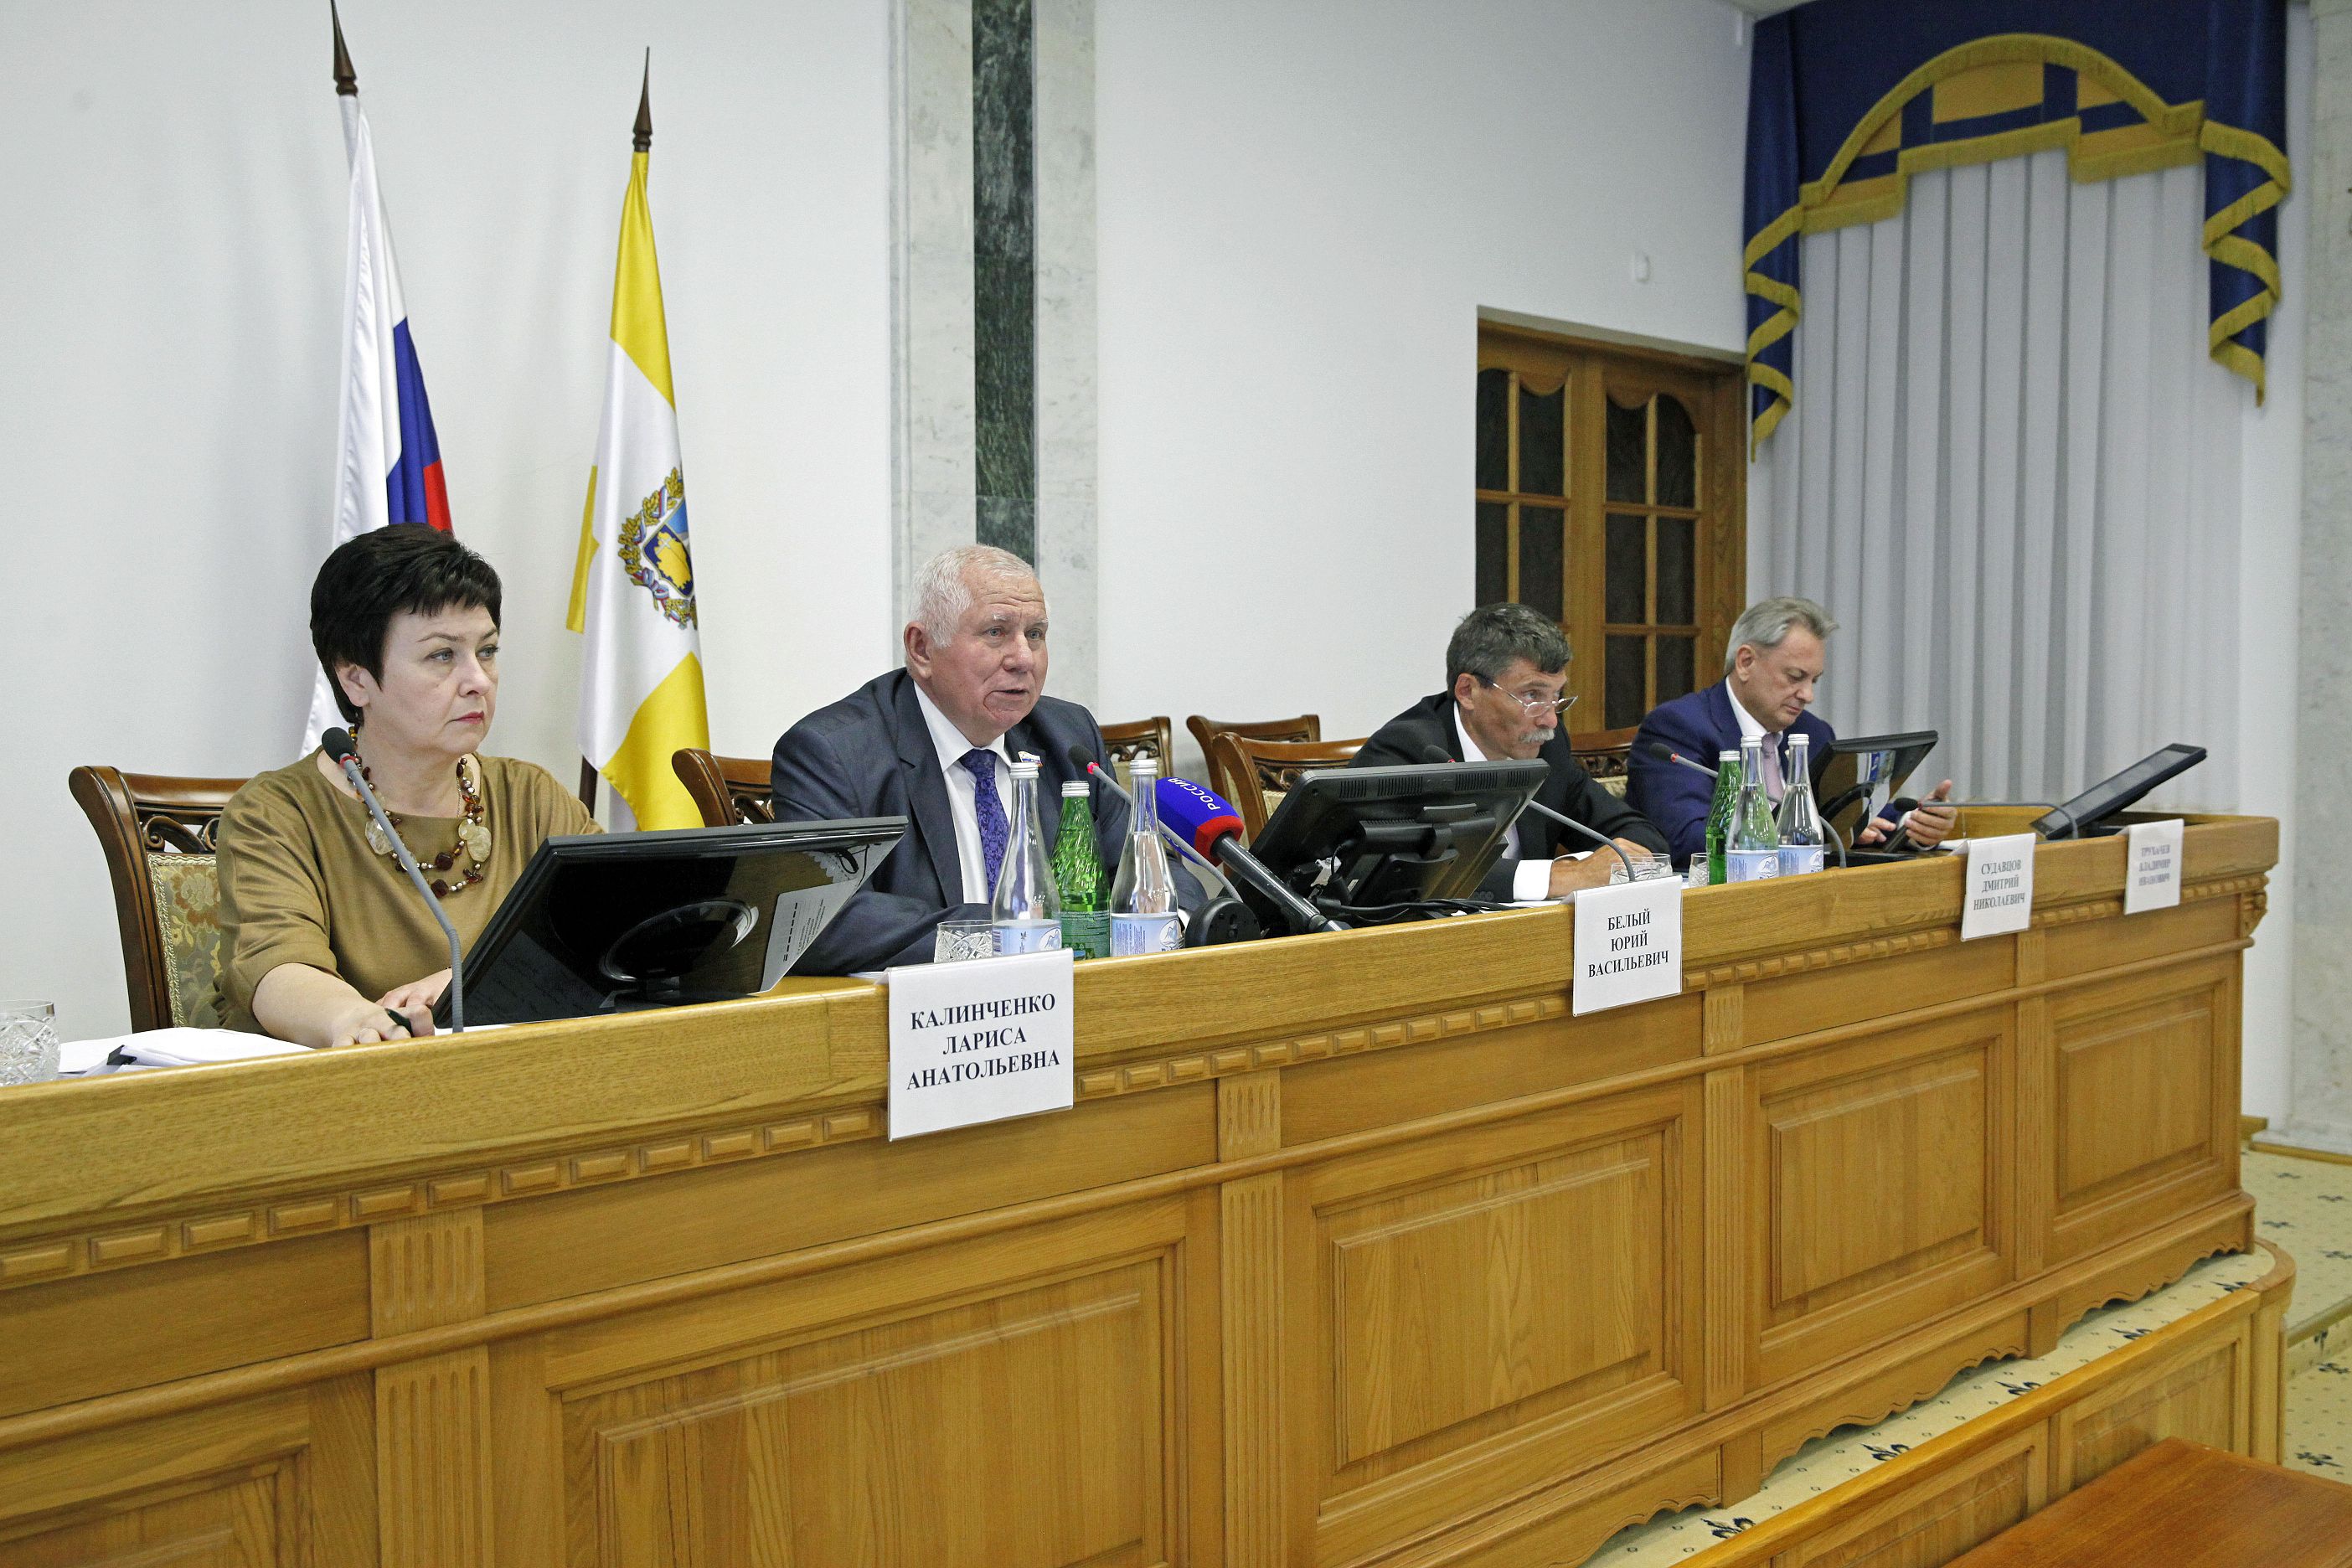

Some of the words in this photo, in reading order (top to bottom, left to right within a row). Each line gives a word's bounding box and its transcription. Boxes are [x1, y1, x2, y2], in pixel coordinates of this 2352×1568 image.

[1167, 777, 1221, 811] РОССИЯ
[1981, 859, 2022, 874] СУДАВЦОВ
[1982, 874, 2019, 893] ДМИТРИЙ
[1973, 892, 2025, 910] НИКОЛАЕВИЧ
[1607, 907, 1651, 931] БЕЛЫЙ
[1611, 930, 1648, 952] ЮРИЙ
[1588, 950, 1669, 977] ВАСИЛЬЕВИЧ
[910, 993, 1056, 1030] КАЛИНЧЕНКО
[942, 1026, 1027, 1055] ЛАРИСА
[906, 1050, 1060, 1090] АНАТОЛЬЕВНА
